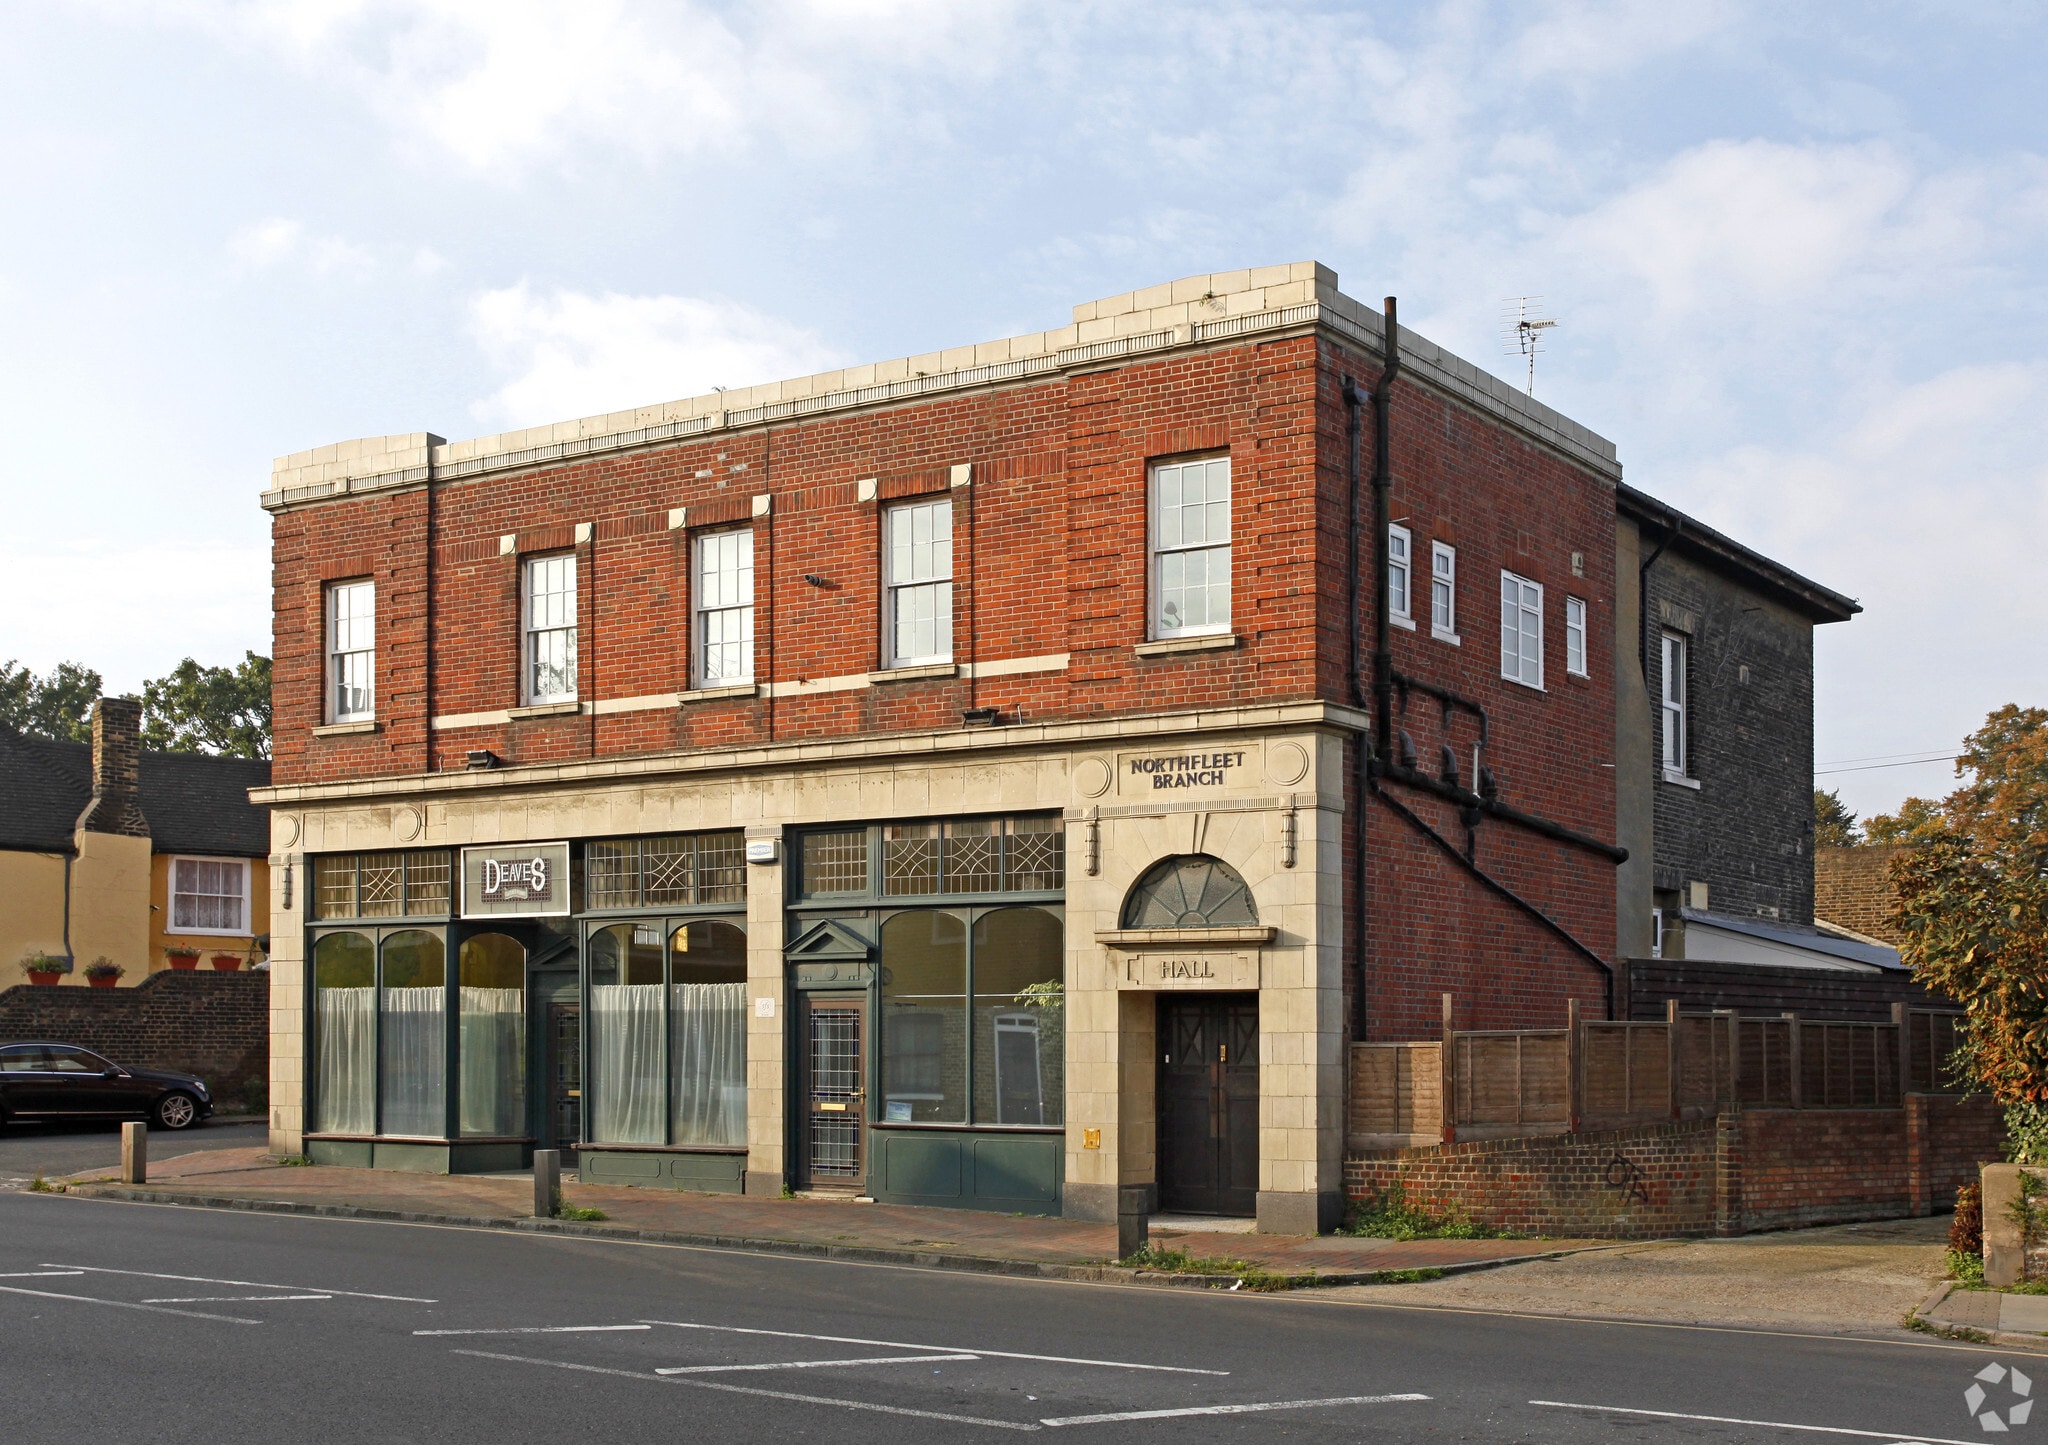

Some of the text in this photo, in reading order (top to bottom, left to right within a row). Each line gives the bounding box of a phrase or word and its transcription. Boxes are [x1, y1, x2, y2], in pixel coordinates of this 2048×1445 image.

[1131, 752, 1246, 775] NORTHFLEET
[1153, 770, 1223, 789] BRANCH
[485, 857, 546, 894] DEAVES
[1161, 960, 1215, 979] HALL
